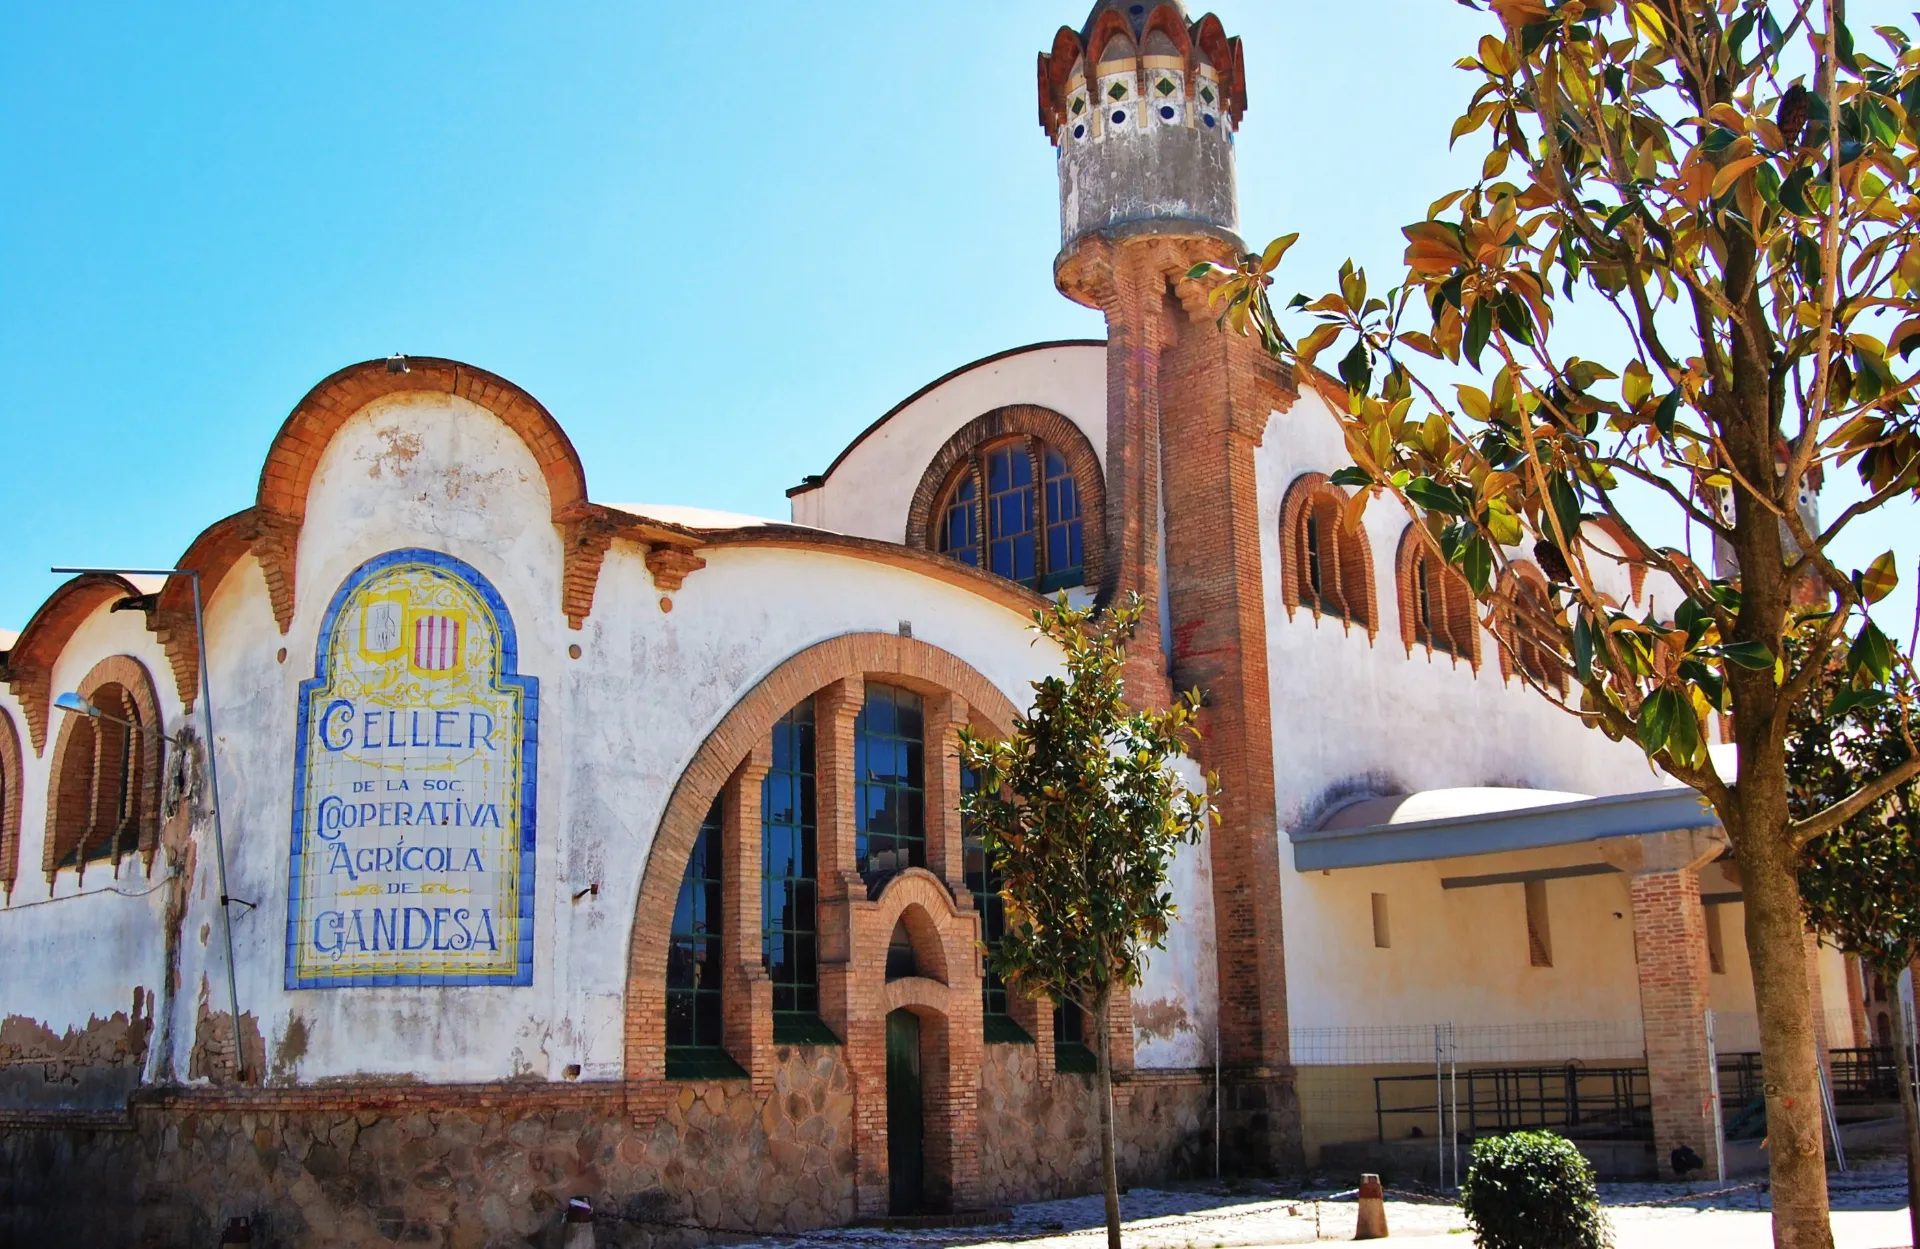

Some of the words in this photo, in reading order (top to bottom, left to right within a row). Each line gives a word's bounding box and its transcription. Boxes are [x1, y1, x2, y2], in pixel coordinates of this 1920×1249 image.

[318, 699, 497, 753] CELLER
[353, 780, 374, 793] DE
[387, 779, 410, 791] LA
[423, 779, 465, 792] SOC.
[328, 836, 484, 881] AGRÍCOLA
[388, 882, 411, 895] DE
[314, 907, 499, 961] GANDESA
